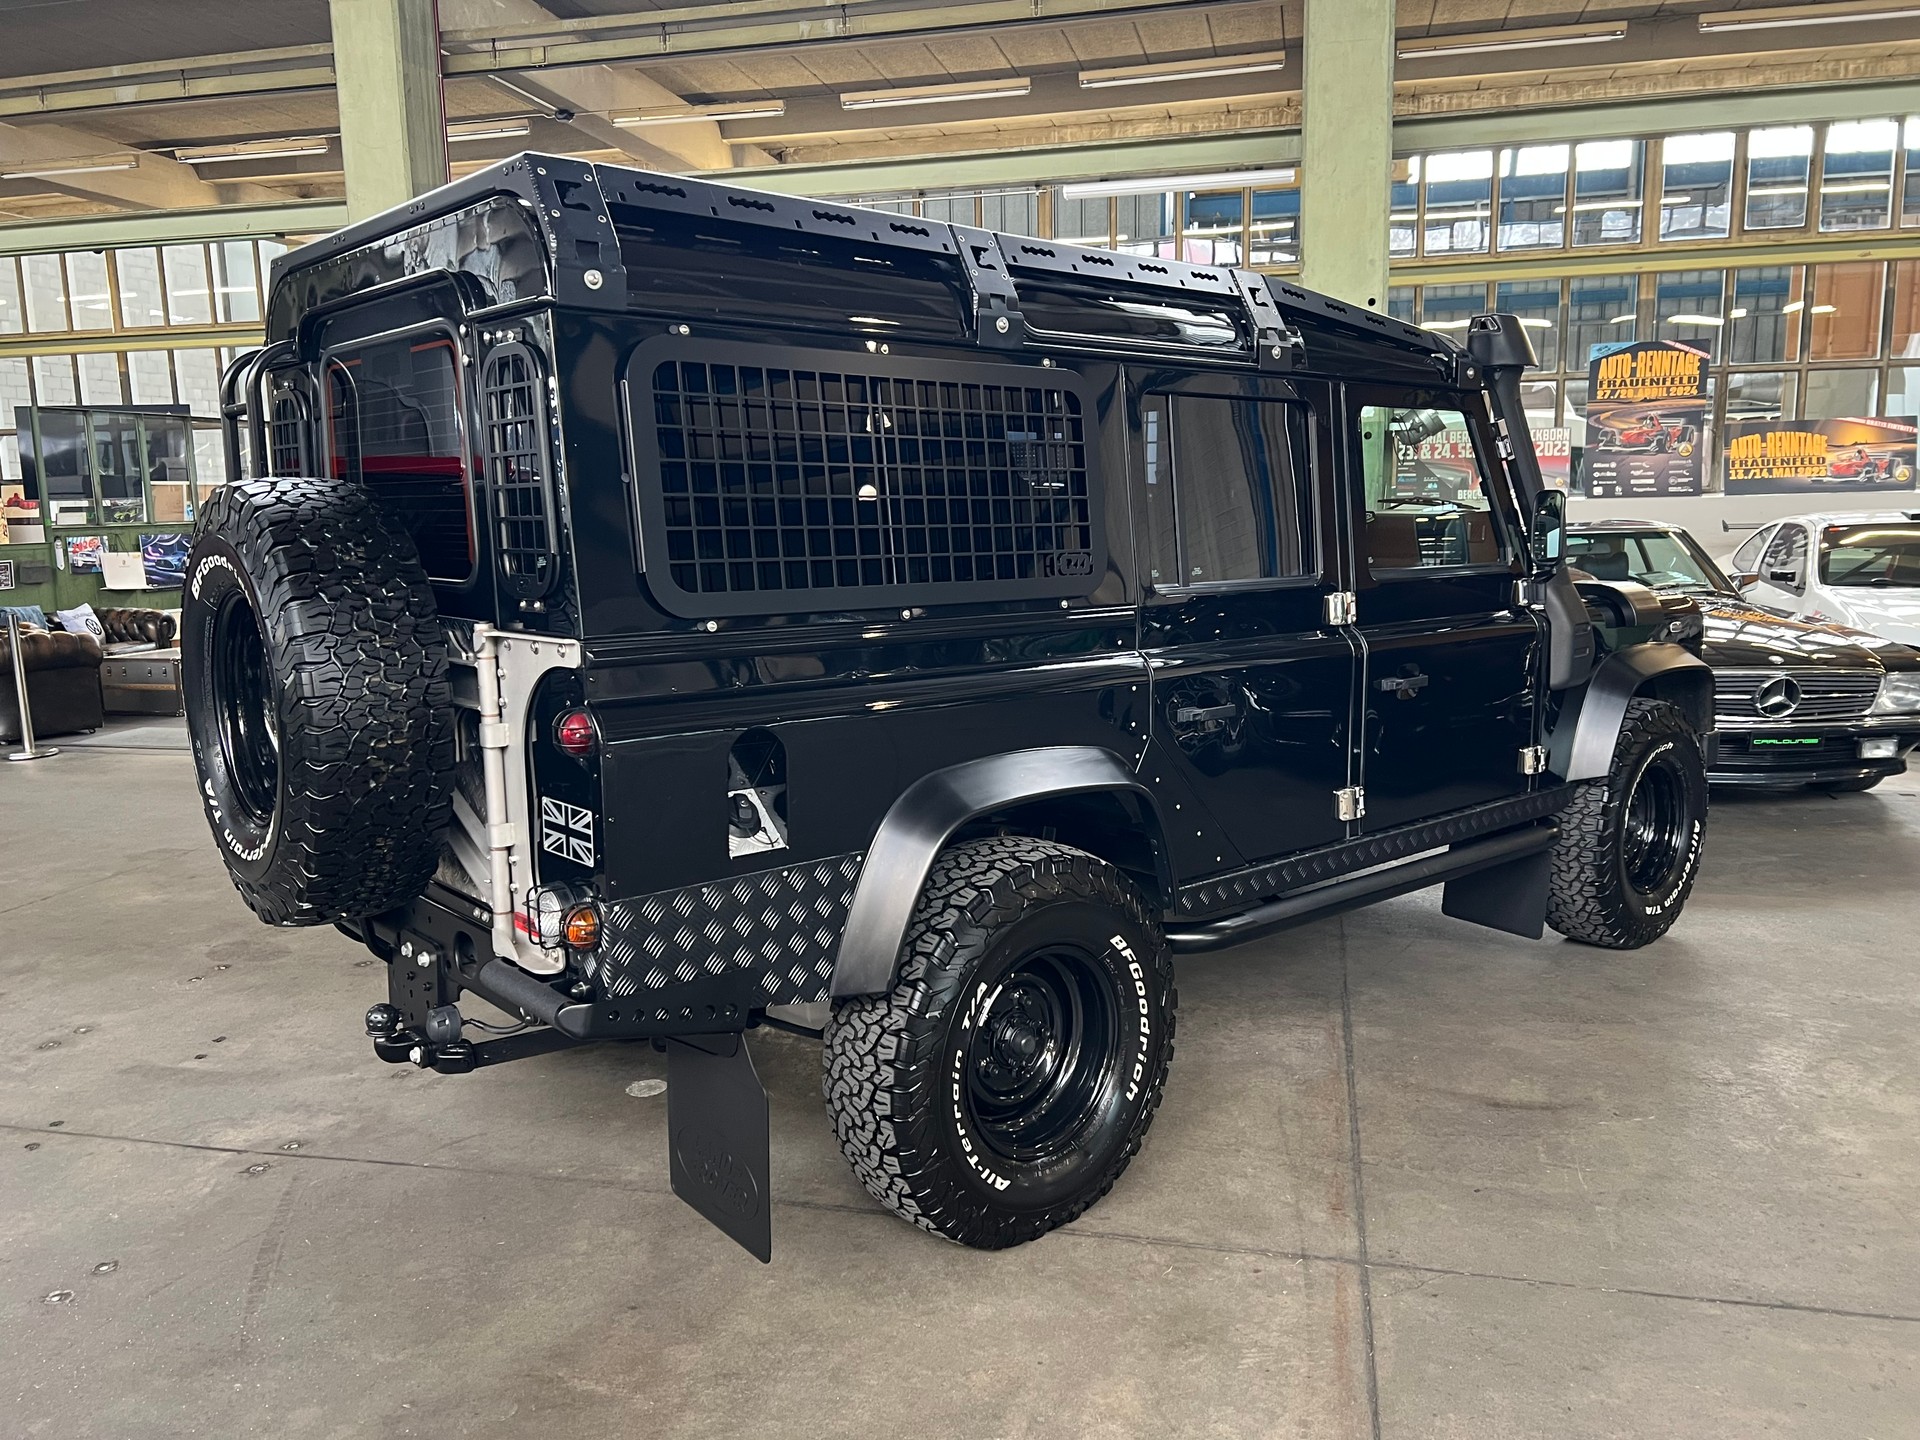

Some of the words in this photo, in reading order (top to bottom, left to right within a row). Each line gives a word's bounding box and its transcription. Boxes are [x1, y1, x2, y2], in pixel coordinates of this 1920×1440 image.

[1599, 351, 1701, 380] AUTO-RENNTAGE
[1598, 375, 1699, 389] FRAUENFELD
[1669, 385, 1698, 398] 2024
[1531, 428, 1570, 442] CKBORN
[1398, 444, 1418, 461] 23.
[1420, 444, 1432, 460] &
[1434, 443, 1456, 459] 24.
[1535, 441, 1570, 457] 2023
[1730, 431, 1828, 460] AUTO-RENNTAGE
[1730, 456, 1827, 469] FRAUENFELD
[1797, 466, 1828, 478] 2023
[1664, 819, 1701, 908] All-Terrain
[1645, 904, 1663, 915] T/A
[961, 981, 988, 1030] T/A
[1109, 934, 1152, 1102] BFGoodrich
[953, 1049, 1012, 1191] All-Terrain
